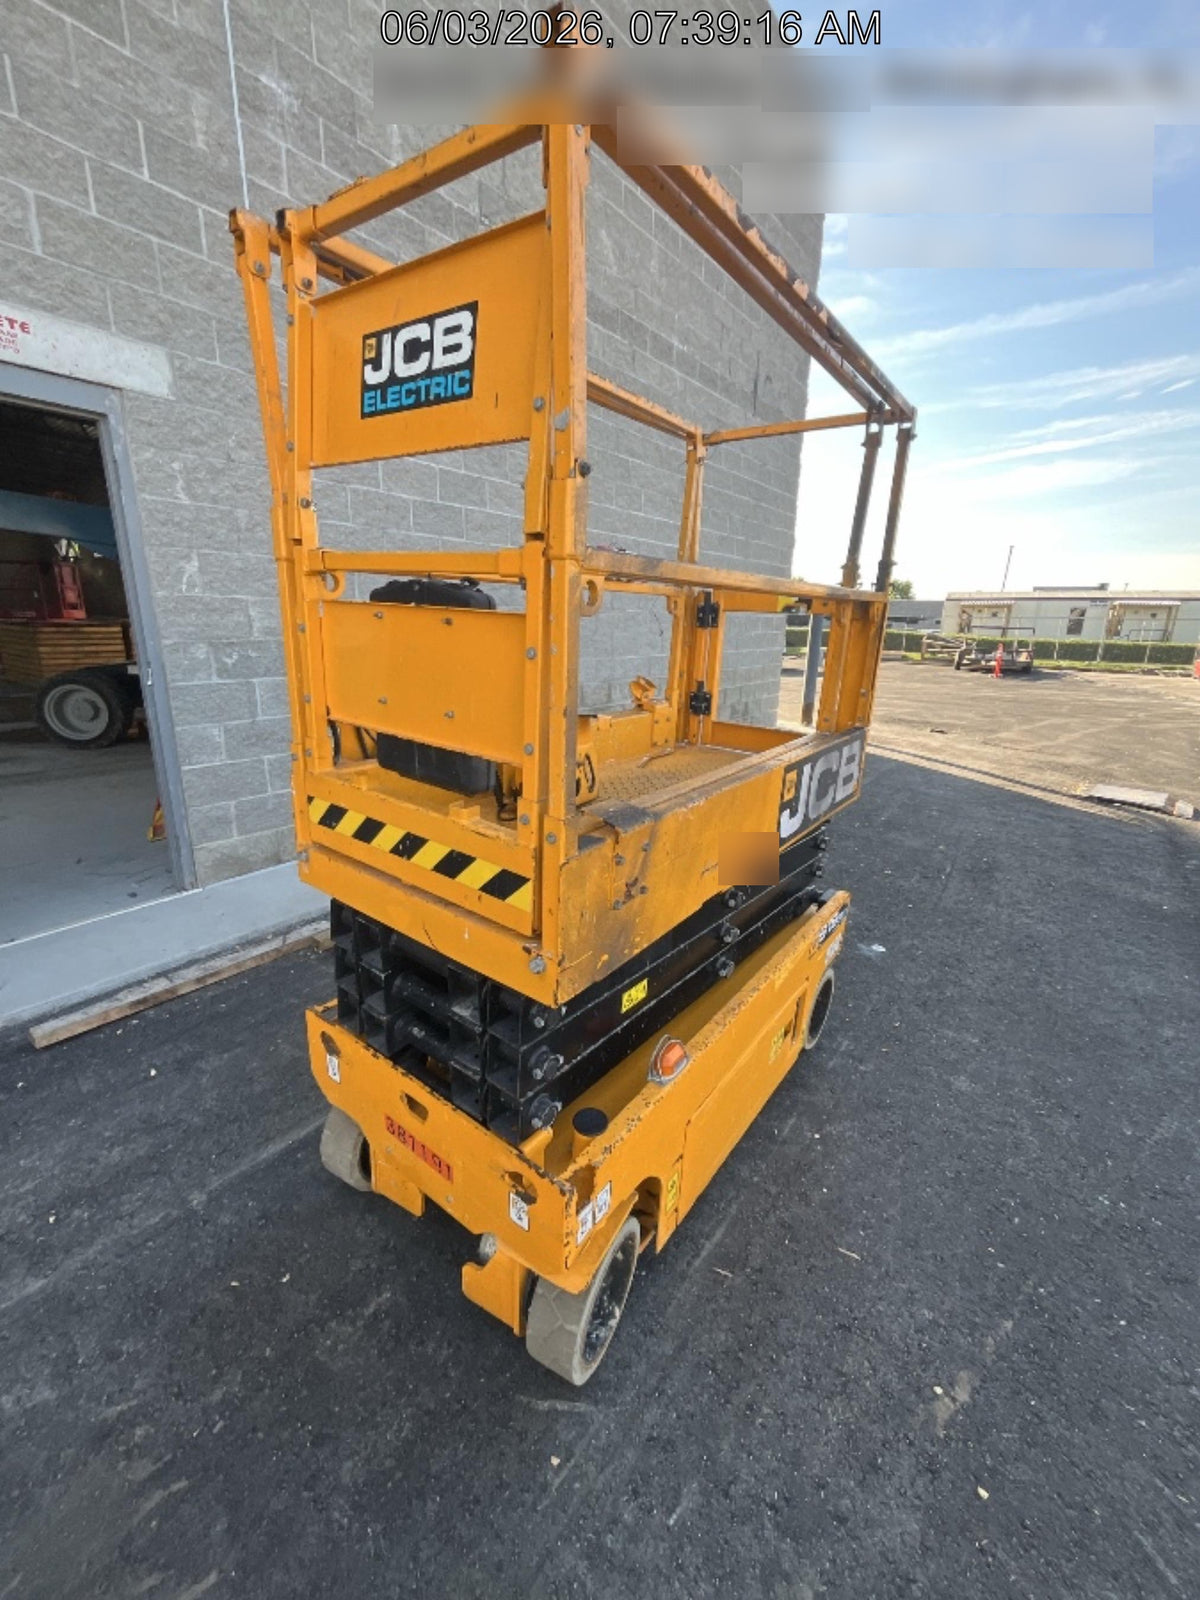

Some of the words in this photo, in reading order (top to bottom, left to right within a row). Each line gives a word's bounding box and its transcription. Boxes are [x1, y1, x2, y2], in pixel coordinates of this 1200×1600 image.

[0, 315, 31, 335] TE
[364, 310, 474, 385] JCB
[363, 369, 471, 413] ELECTRIC
[780, 739, 861, 838] JCB
